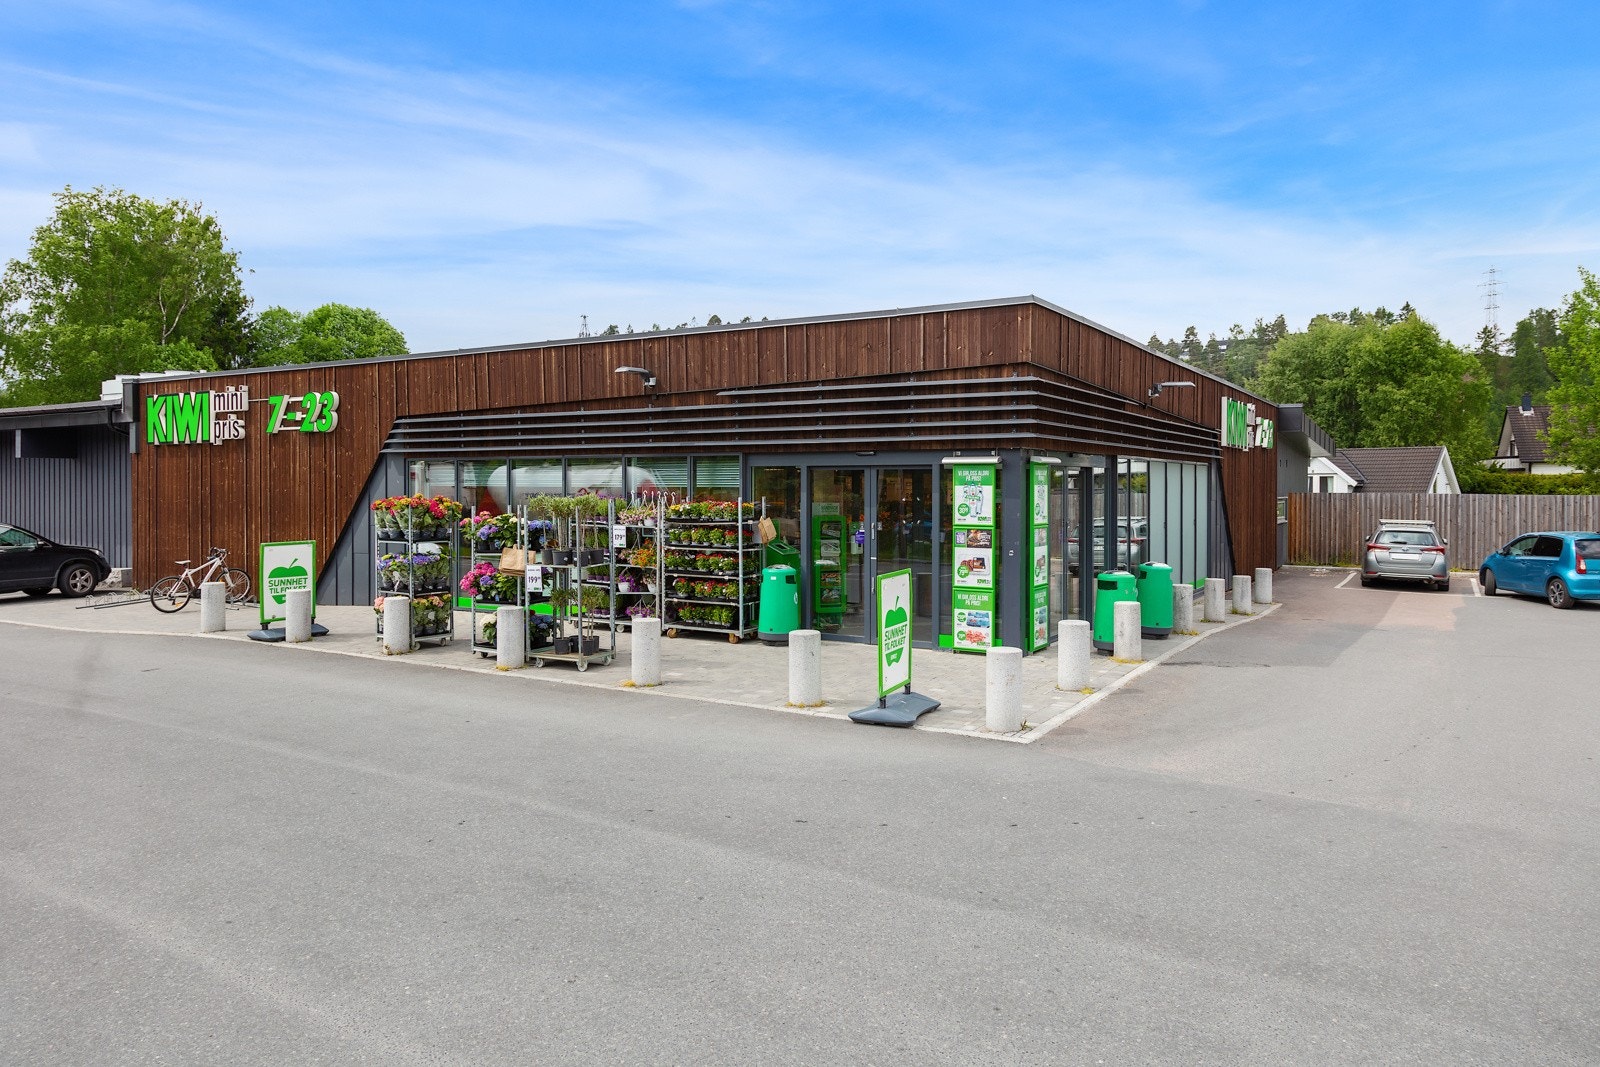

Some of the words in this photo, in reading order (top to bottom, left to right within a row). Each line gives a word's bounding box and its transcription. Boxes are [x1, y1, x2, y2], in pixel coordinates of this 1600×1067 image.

[213, 385, 246, 411] mini
[146, 391, 210, 444] KIWI
[266, 391, 337, 434] 7-23
[1222, 397, 1248, 448] KIWI
[213, 414, 243, 445] pris
[268, 577, 308, 588] SUNNHET
[884, 624, 907, 641] SUNNHET
[891, 636, 905, 648] FOLKET
